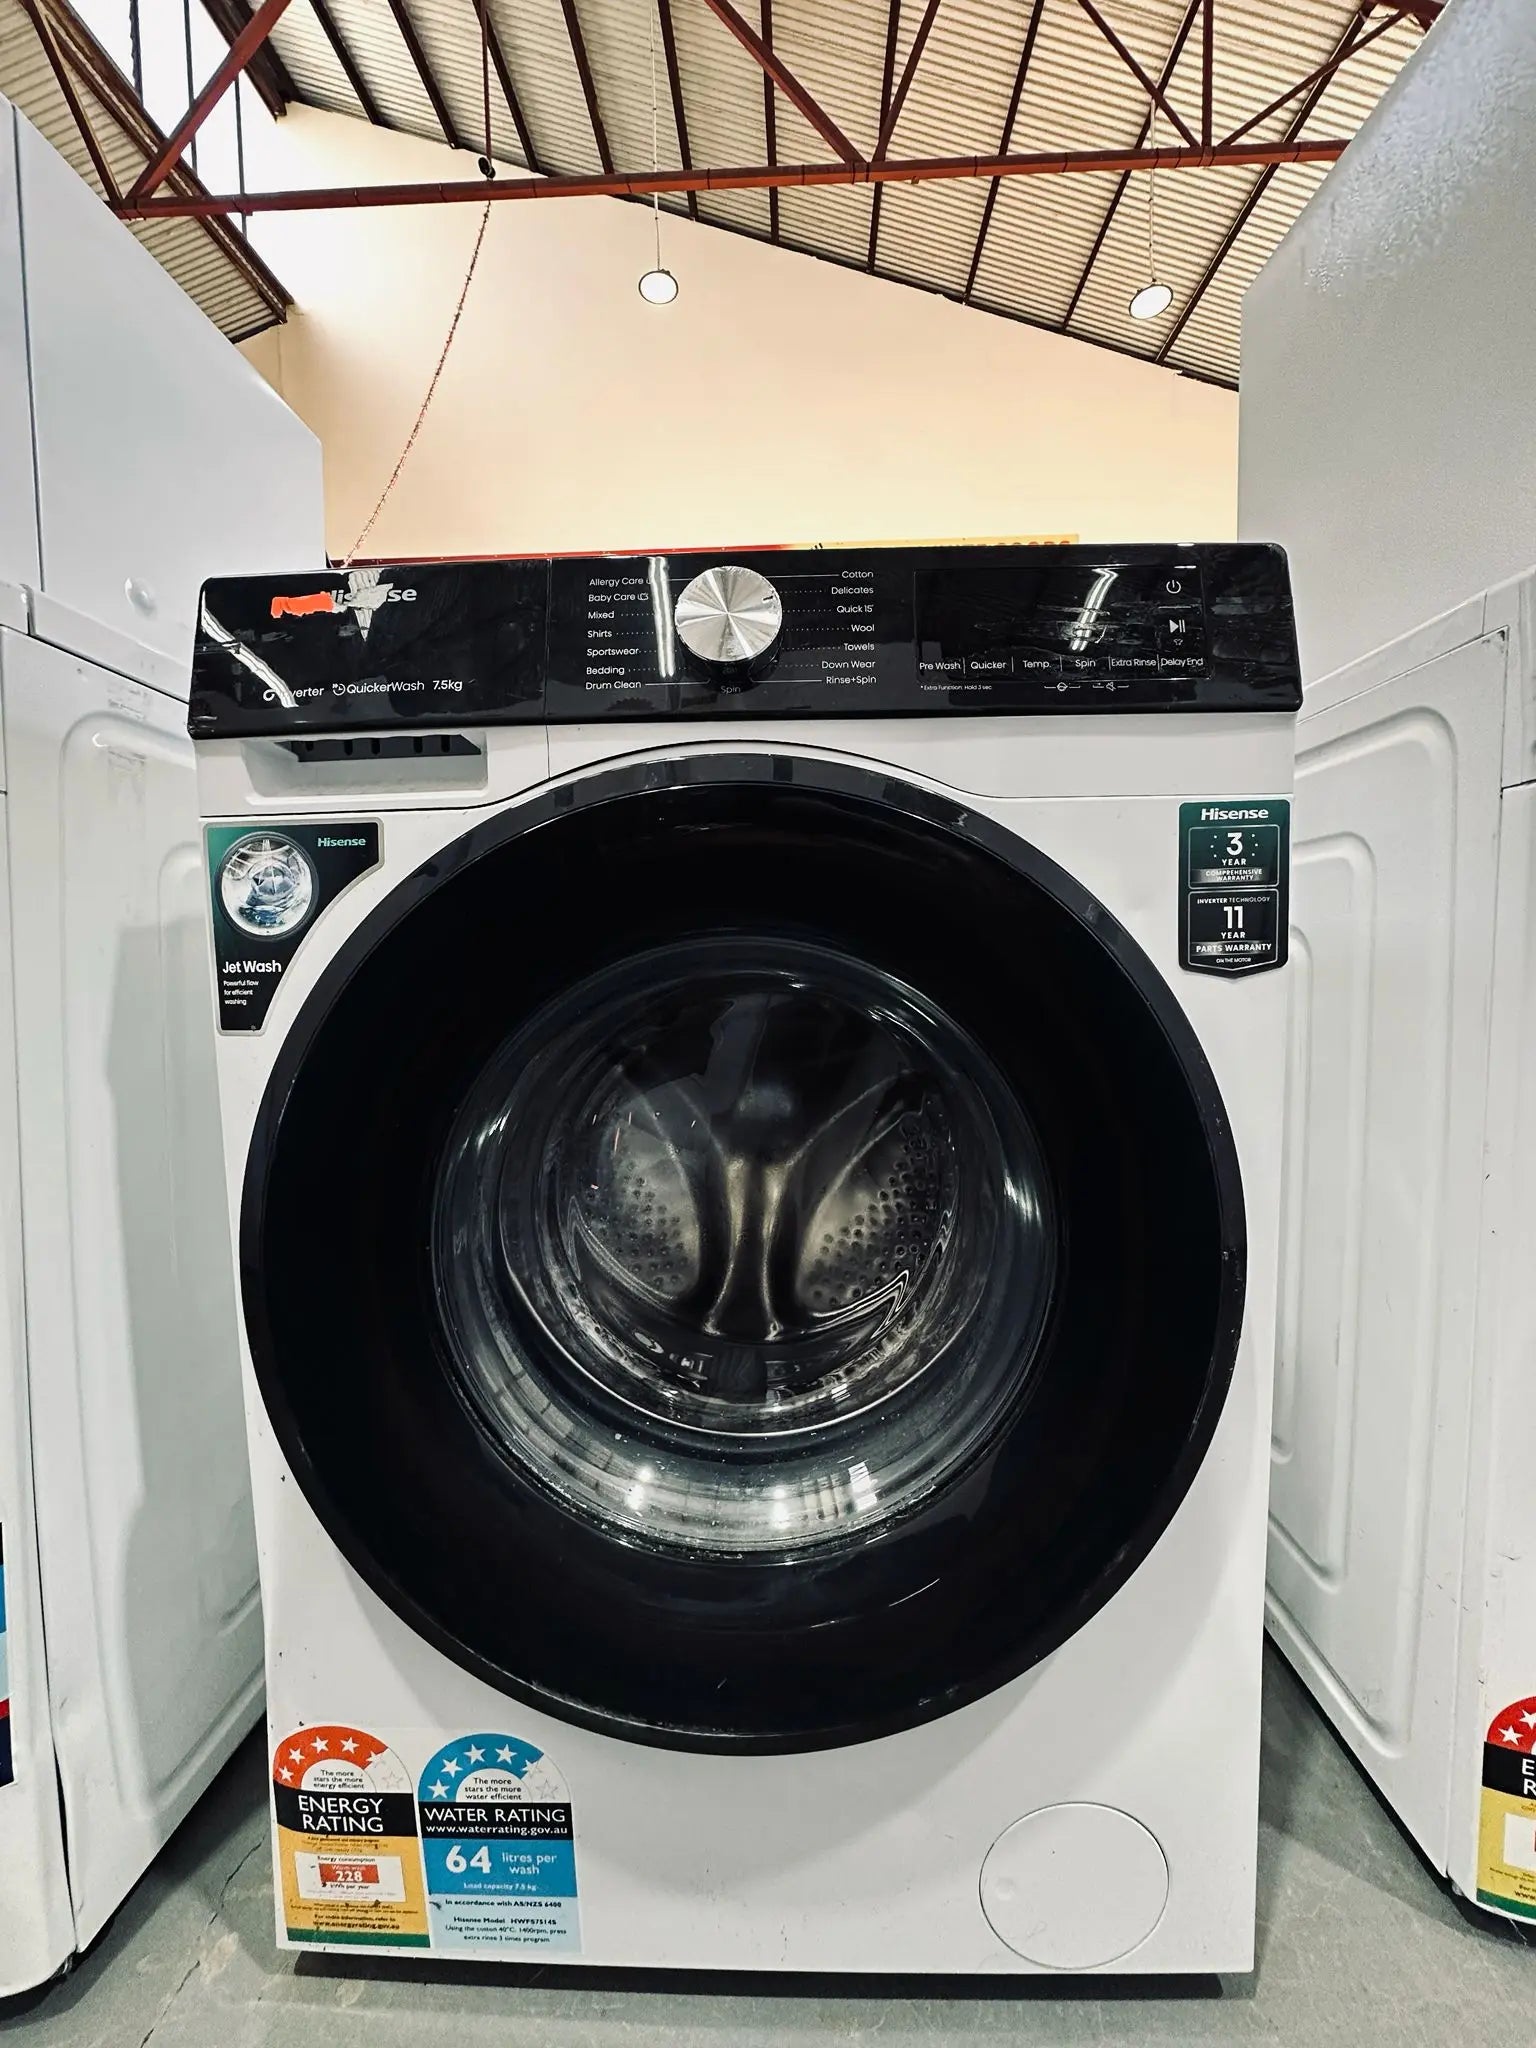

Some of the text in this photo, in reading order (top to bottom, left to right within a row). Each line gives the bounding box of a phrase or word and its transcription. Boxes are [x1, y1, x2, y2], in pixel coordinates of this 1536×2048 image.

[841, 570, 874, 579] Cotton
[589, 577, 644, 588] Allergy Care
[831, 586, 874, 595] Delicates
[588, 593, 636, 603] Baby Care
[836, 604, 863, 613] Quick
[588, 610, 615, 619] Mixed
[850, 623, 875, 632] Wool
[587, 629, 613, 638] Shirts
[843, 642, 875, 651] Towels
[586, 648, 639, 658] Sportswear
[821, 660, 876, 669] Down Wear
[919, 661, 961, 670] Pre Wash
[970, 661, 1007, 670] Quicker
[1022, 660, 1052, 670] Temp.
[1075, 659, 1096, 669] Spin
[1111, 658, 1157, 667] Extra Rinse
[1160, 657, 1204, 668] Delay End
[586, 666, 625, 675] Bedding
[826, 675, 877, 685] Rinse+Spin
[346, 681, 425, 694] QuickerWash
[432, 680, 463, 692] 7.5kg
[585, 681, 642, 690] Drum Clean
[720, 685, 741, 695] Spin
[1201, 808, 1269, 821] Hisense
[317, 837, 366, 847] Hisense
[1226, 832, 1243, 856] 3
[1221, 858, 1247, 866] YEAR
[1205, 868, 1263, 877] COMPREHENSIVE
[1223, 905, 1243, 929] 11
[1220, 931, 1246, 939] YEAR
[1196, 943, 1272, 953] PARTS WARRANTY
[222, 960, 282, 973] Jet Wash
[224, 998, 247, 1006] washing
[320, 1769, 334, 1777] The
[473, 1777, 488, 1785] The
[298, 1795, 384, 1814] ENERGY
[424, 1807, 566, 1822] WATER RATING
[302, 1813, 384, 1833] RATING
[425, 1824, 568, 1836] www.waterrating.gov.au
[445, 1844, 557, 1874] 64 litres per
[509, 1864, 540, 1875] wash
[336, 1871, 363, 1882] 228
